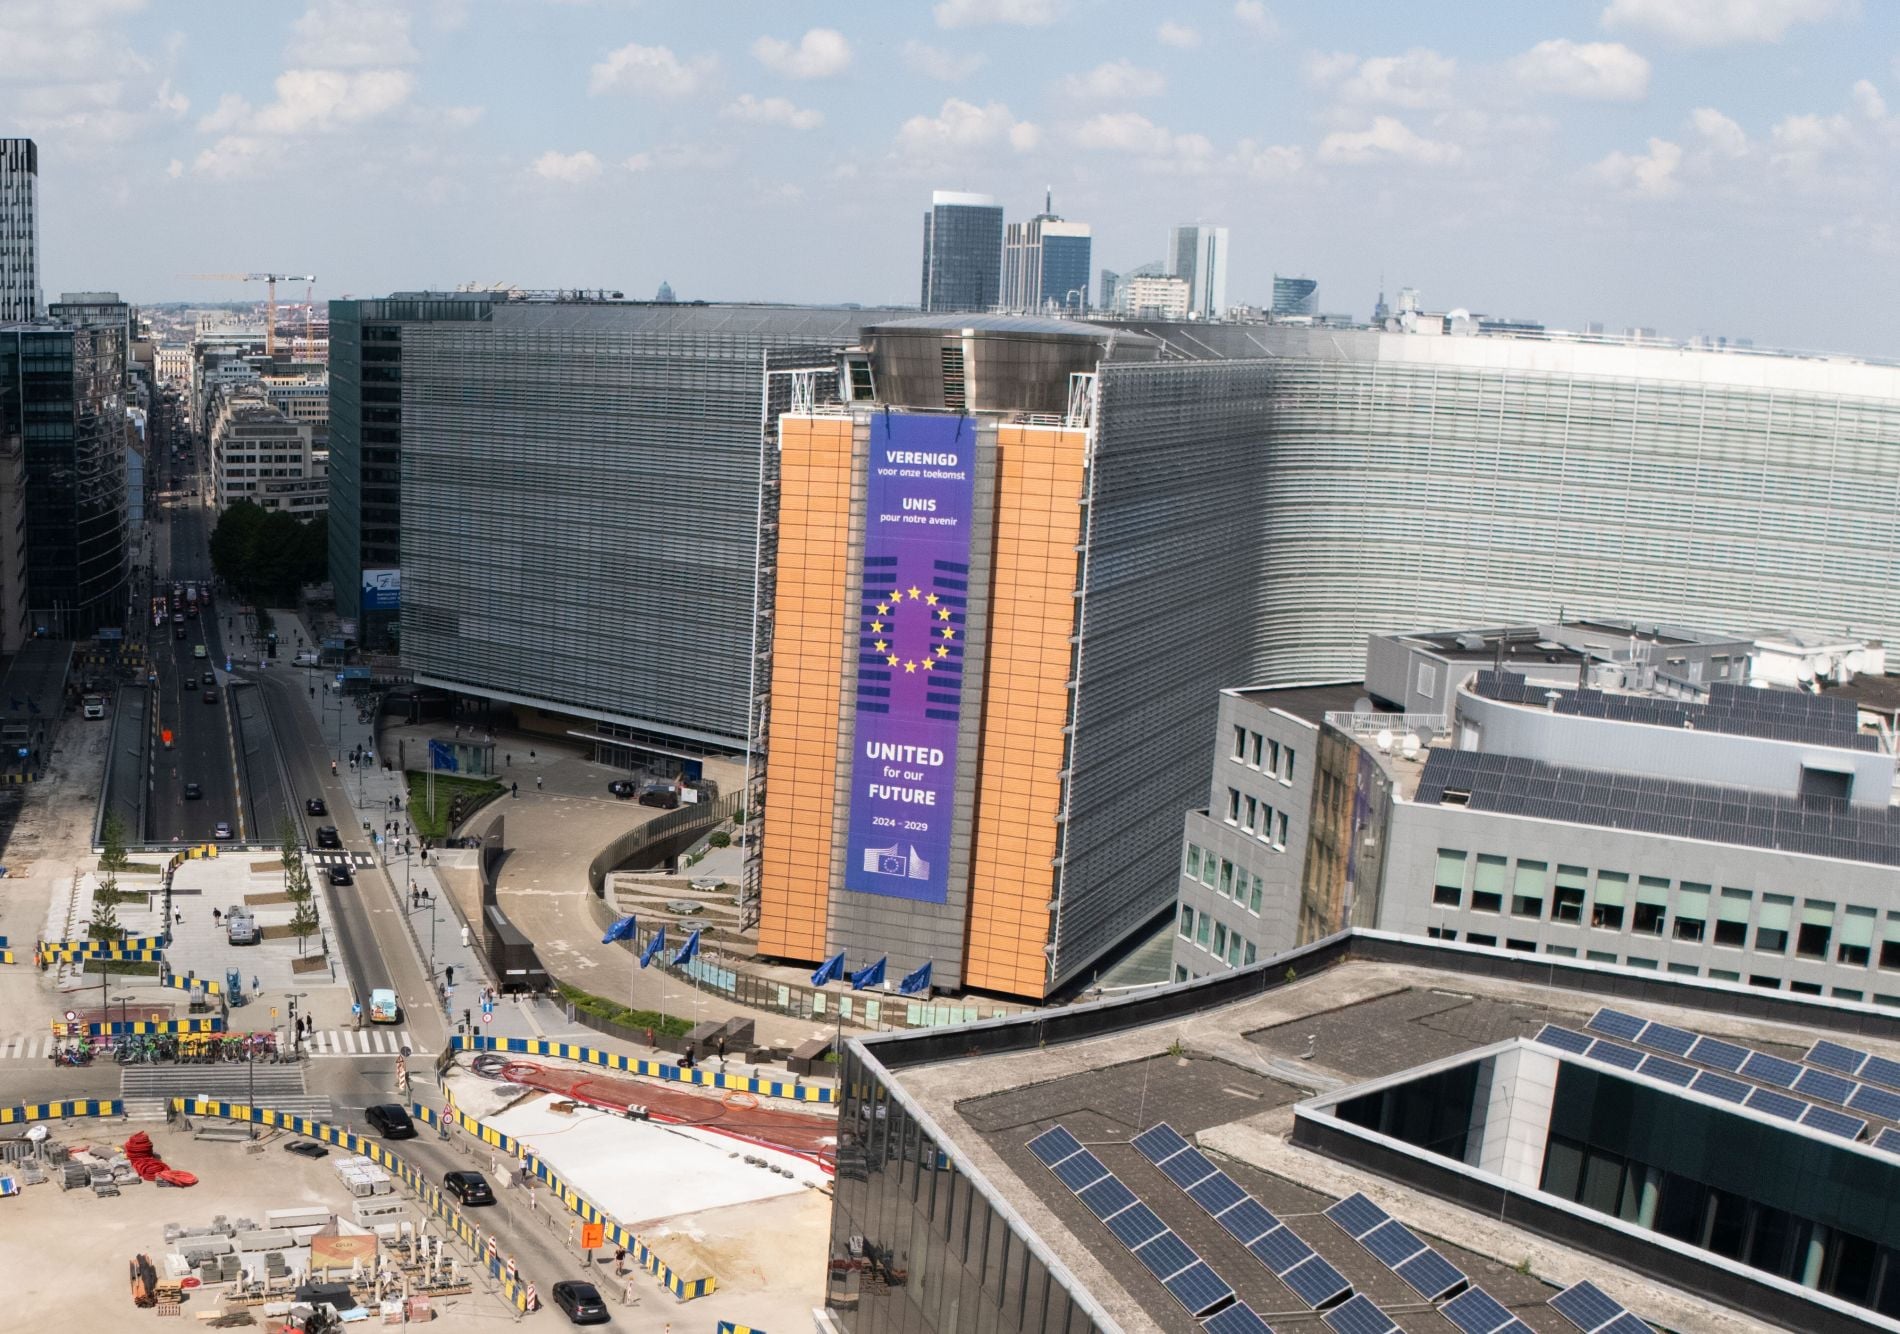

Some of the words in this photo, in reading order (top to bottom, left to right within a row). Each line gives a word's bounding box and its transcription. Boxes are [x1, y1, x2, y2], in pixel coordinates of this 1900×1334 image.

[886, 451, 958, 466] VERENIGD
[878, 468, 897, 476] voor
[899, 469, 921, 477] onze
[923, 469, 966, 480] toekomst
[902, 498, 936, 511] UNIS
[880, 513, 900, 523] pour
[902, 514, 927, 524] notre
[928, 516, 958, 526] avenir
[867, 742, 944, 766] UNITED
[883, 766, 901, 778] for
[903, 771, 924, 781] our
[869, 784, 935, 805] FUTURE
[872, 816, 896, 828] 2024
[904, 820, 928, 832] 2029
